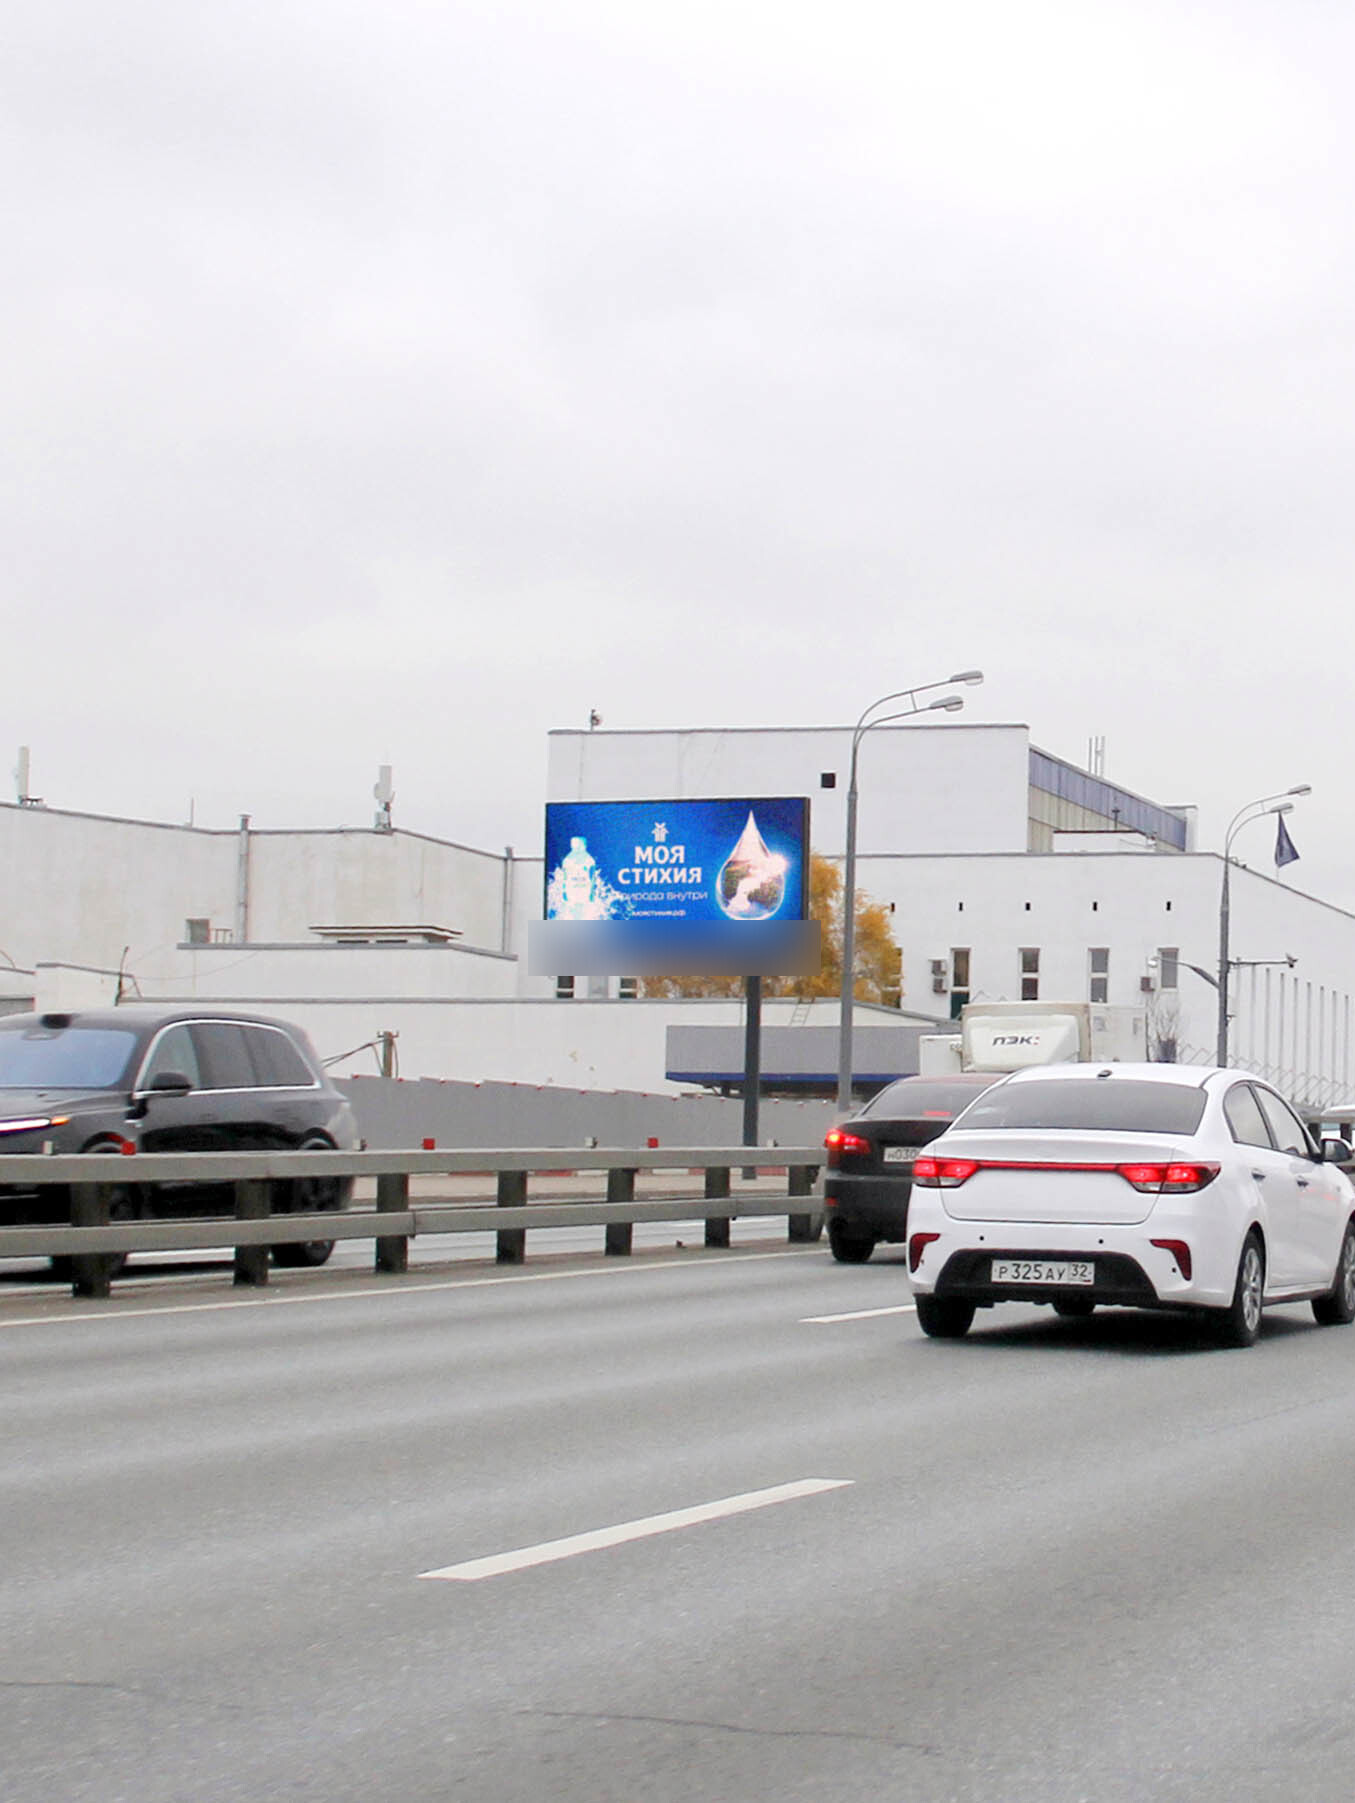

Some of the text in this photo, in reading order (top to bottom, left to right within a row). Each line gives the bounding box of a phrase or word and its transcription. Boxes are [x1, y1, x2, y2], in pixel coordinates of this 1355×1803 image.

[634, 845, 685, 865] МОЯ
[617, 867, 702, 885] СТИХИЯ
[616, 891, 708, 902] рирода внутри
[1071, 1264, 1088, 1277] 32
